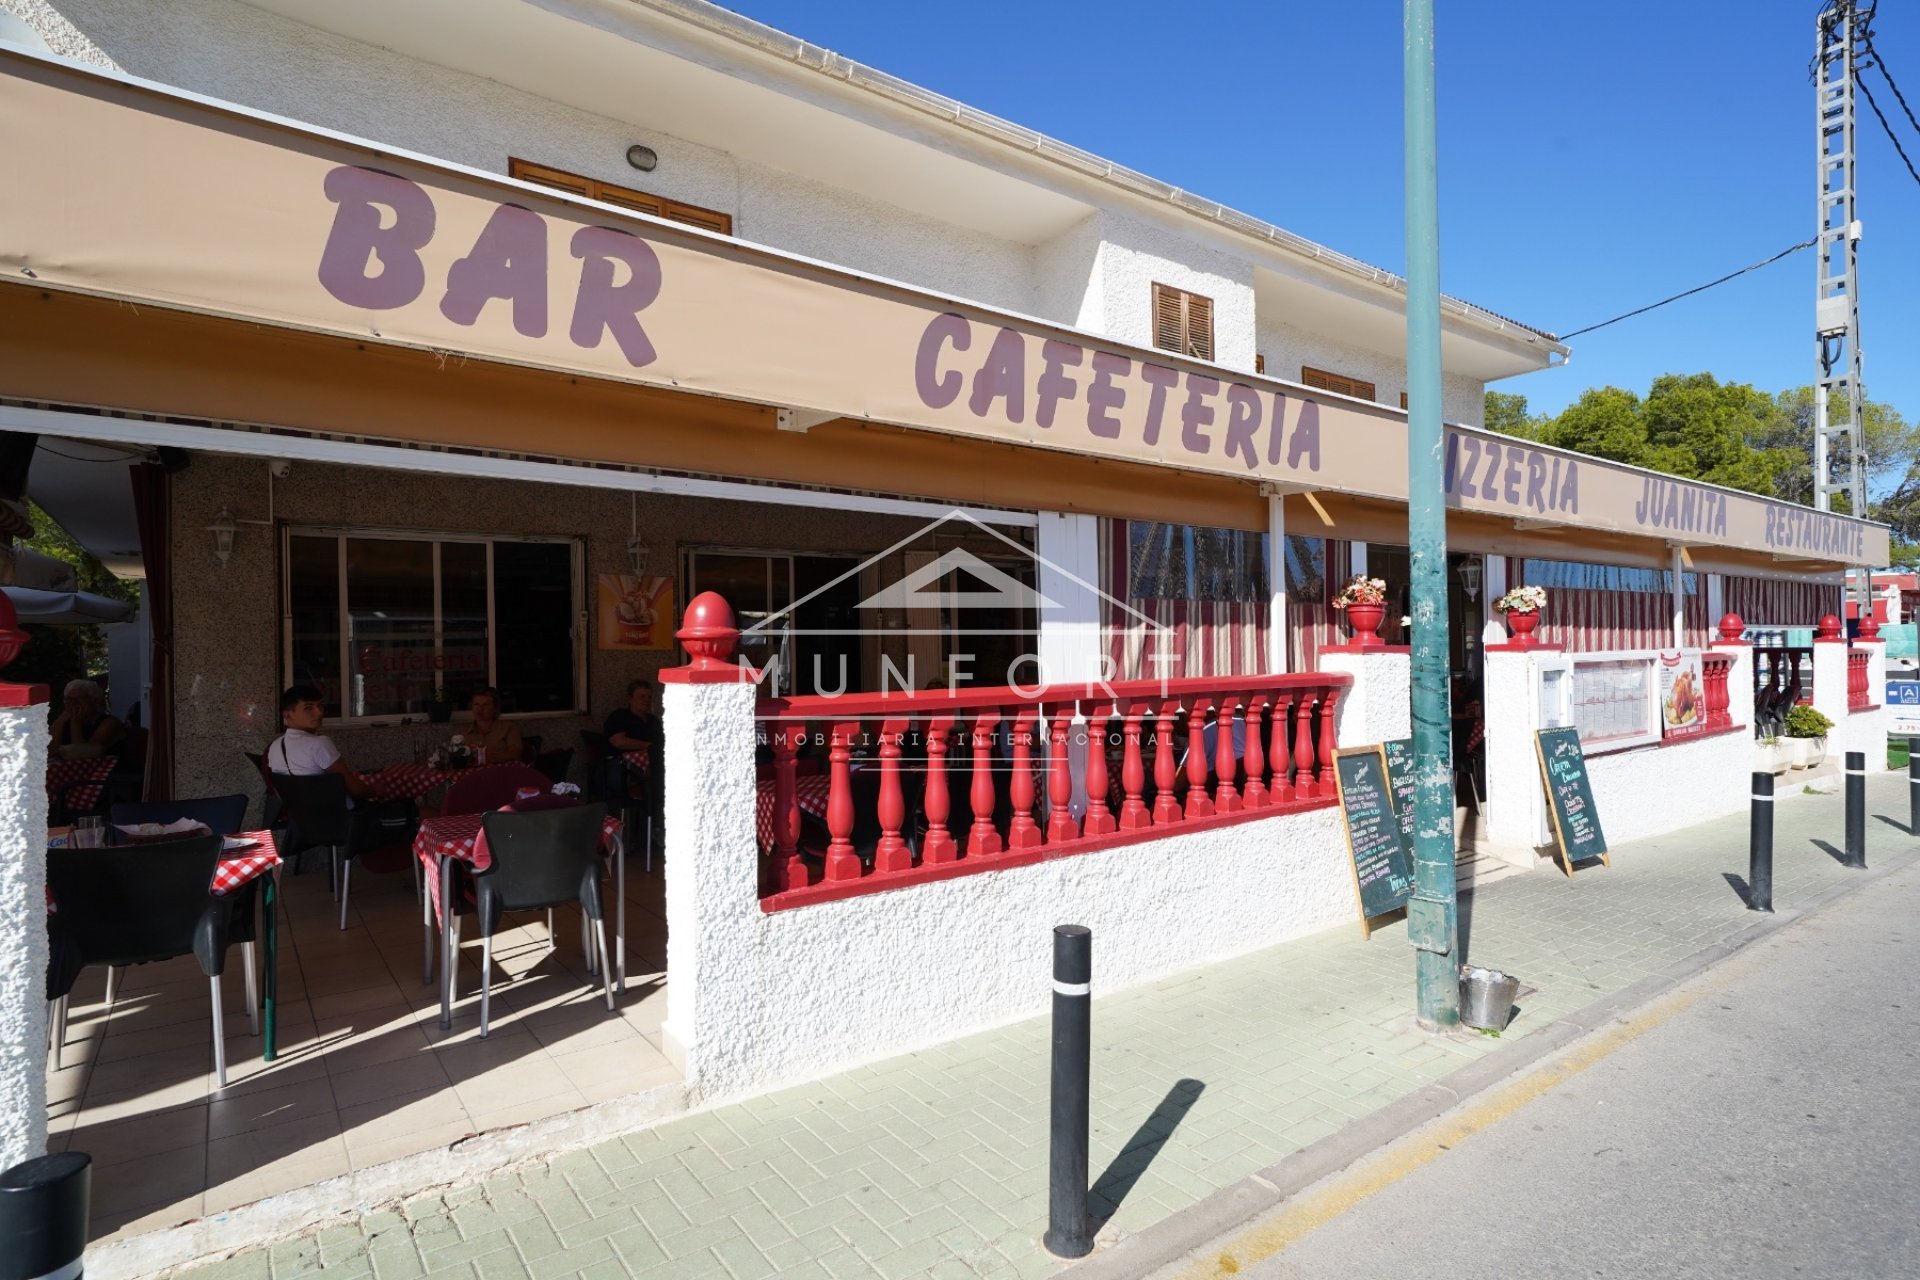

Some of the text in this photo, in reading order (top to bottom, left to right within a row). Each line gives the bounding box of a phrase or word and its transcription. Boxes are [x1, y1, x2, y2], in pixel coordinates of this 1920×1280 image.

[318, 165, 1864, 559] BAR CAFETERIA IZZERIA JUANITA RESTAURANTE
